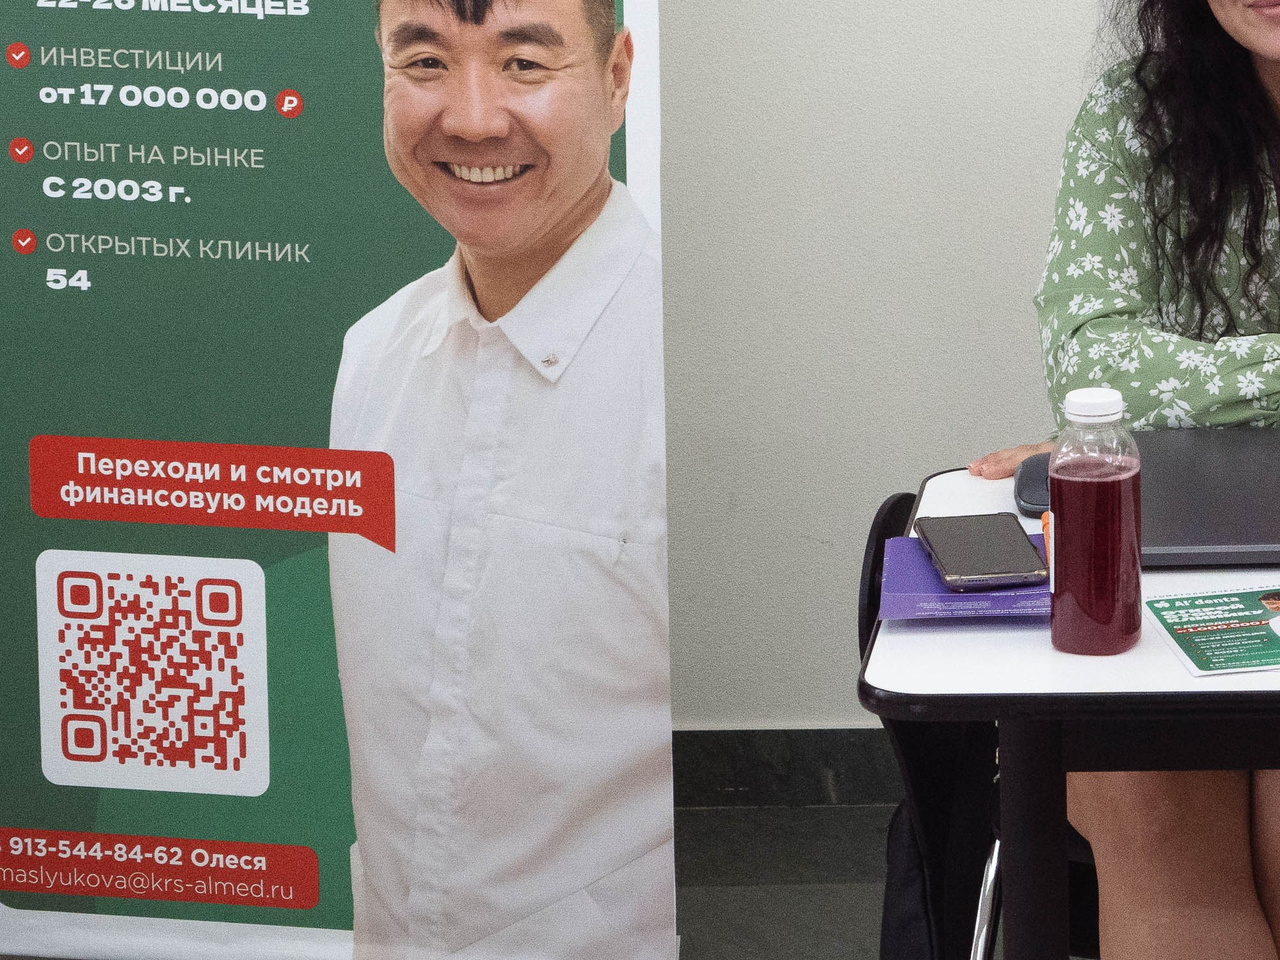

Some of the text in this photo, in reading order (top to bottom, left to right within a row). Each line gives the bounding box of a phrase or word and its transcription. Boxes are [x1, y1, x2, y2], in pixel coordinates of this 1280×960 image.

[40, 45, 223, 74] ИНВЕСТИЦИИ
[39, 86, 76, 105] от
[79, 83, 114, 107] 17
[119, 85, 190, 109] 000
[196, 88, 268, 112] 000
[42, 140, 266, 169] ОПЫТ НА РЫНКЕ
[42, 176, 192, 204] С 2003 г.
[46, 233, 311, 264] ОТКРЫТЫХ КЛИНИК
[46, 268, 92, 291] 54
[76, 451, 363, 492] Переходи и смотри
[60, 481, 364, 518] финансовую модель
[9, 836, 267, 871] 913-544-84-62 Олеся
